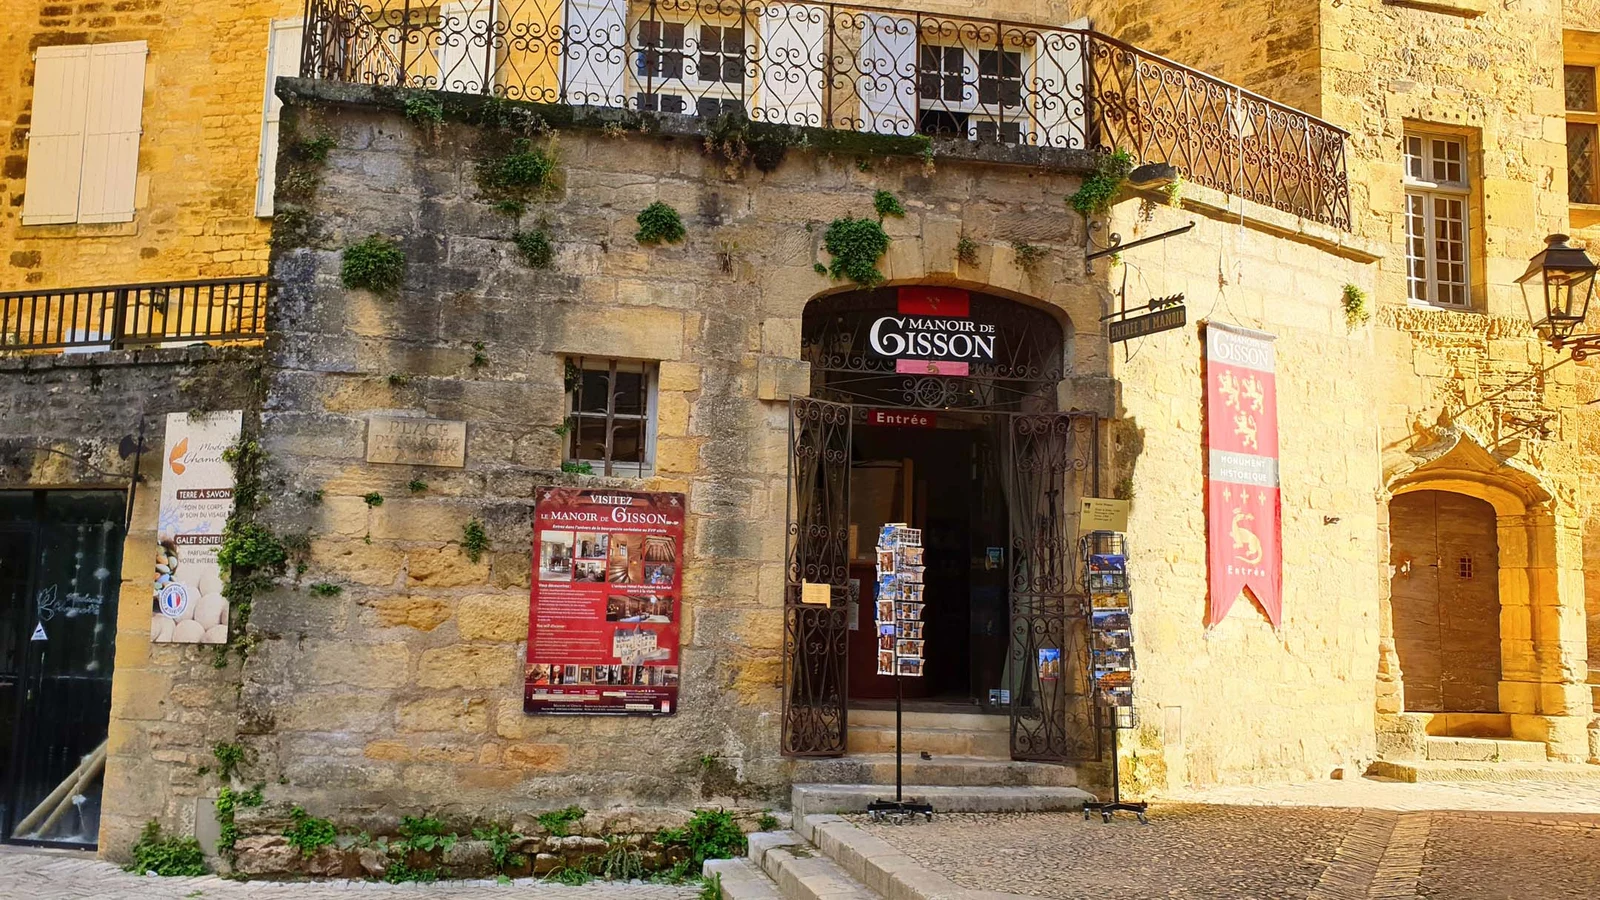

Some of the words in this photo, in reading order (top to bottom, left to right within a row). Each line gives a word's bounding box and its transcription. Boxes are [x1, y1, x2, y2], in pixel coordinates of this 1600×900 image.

[908, 318, 976, 332] MANOIR
[979, 324, 996, 333] DE
[1152, 310, 1185, 329] MANOIR
[869, 316, 997, 359] GISSON
[1213, 331, 1269, 367] GISSON
[876, 412, 928, 426] Entrée
[1221, 455, 1266, 468] MONUMENT
[1220, 468, 1267, 482] HISTORIQUE
[179, 491, 198, 499] TERRE
[199, 489, 205, 498] À
[590, 494, 633, 506] VISITEZ
[551, 510, 598, 522] MANOIR
[611, 506, 667, 525] GISSON
[176, 536, 198, 544] GALET
[199, 536, 224, 544] SENTEU
[1227, 564, 1265, 577] Entrée
